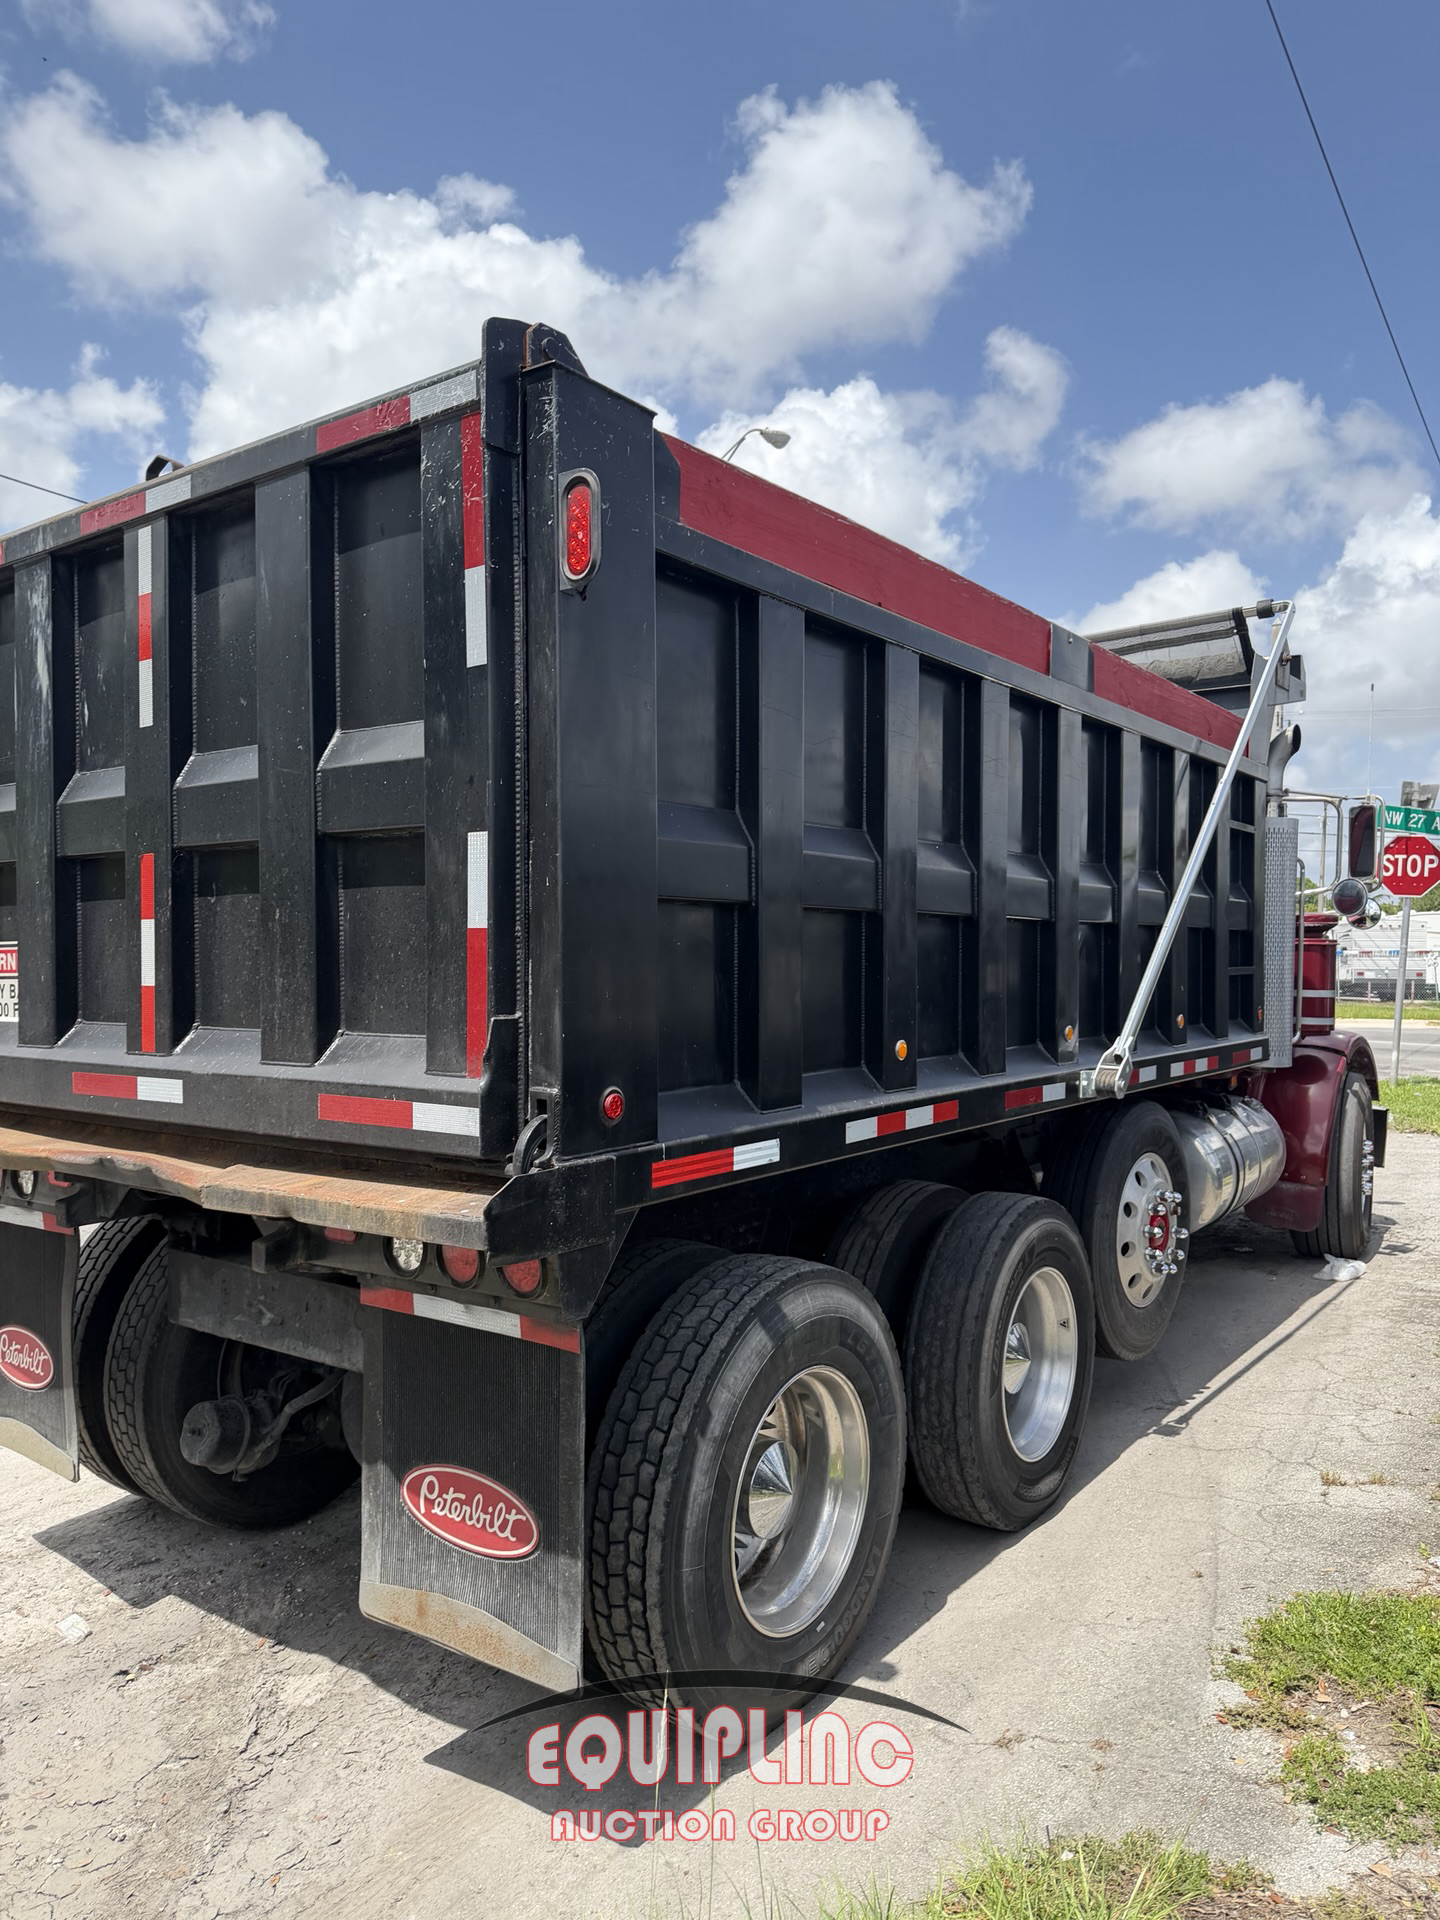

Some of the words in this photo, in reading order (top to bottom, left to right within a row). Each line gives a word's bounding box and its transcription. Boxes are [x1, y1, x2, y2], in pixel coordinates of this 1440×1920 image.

[1385, 810, 1404, 825] NW
[1408, 813, 1427, 828] 27
[1382, 854, 1439, 878] STOP
[0, 1333, 48, 1376] Peterbilt
[419, 1474, 527, 1542] Peterbilt
